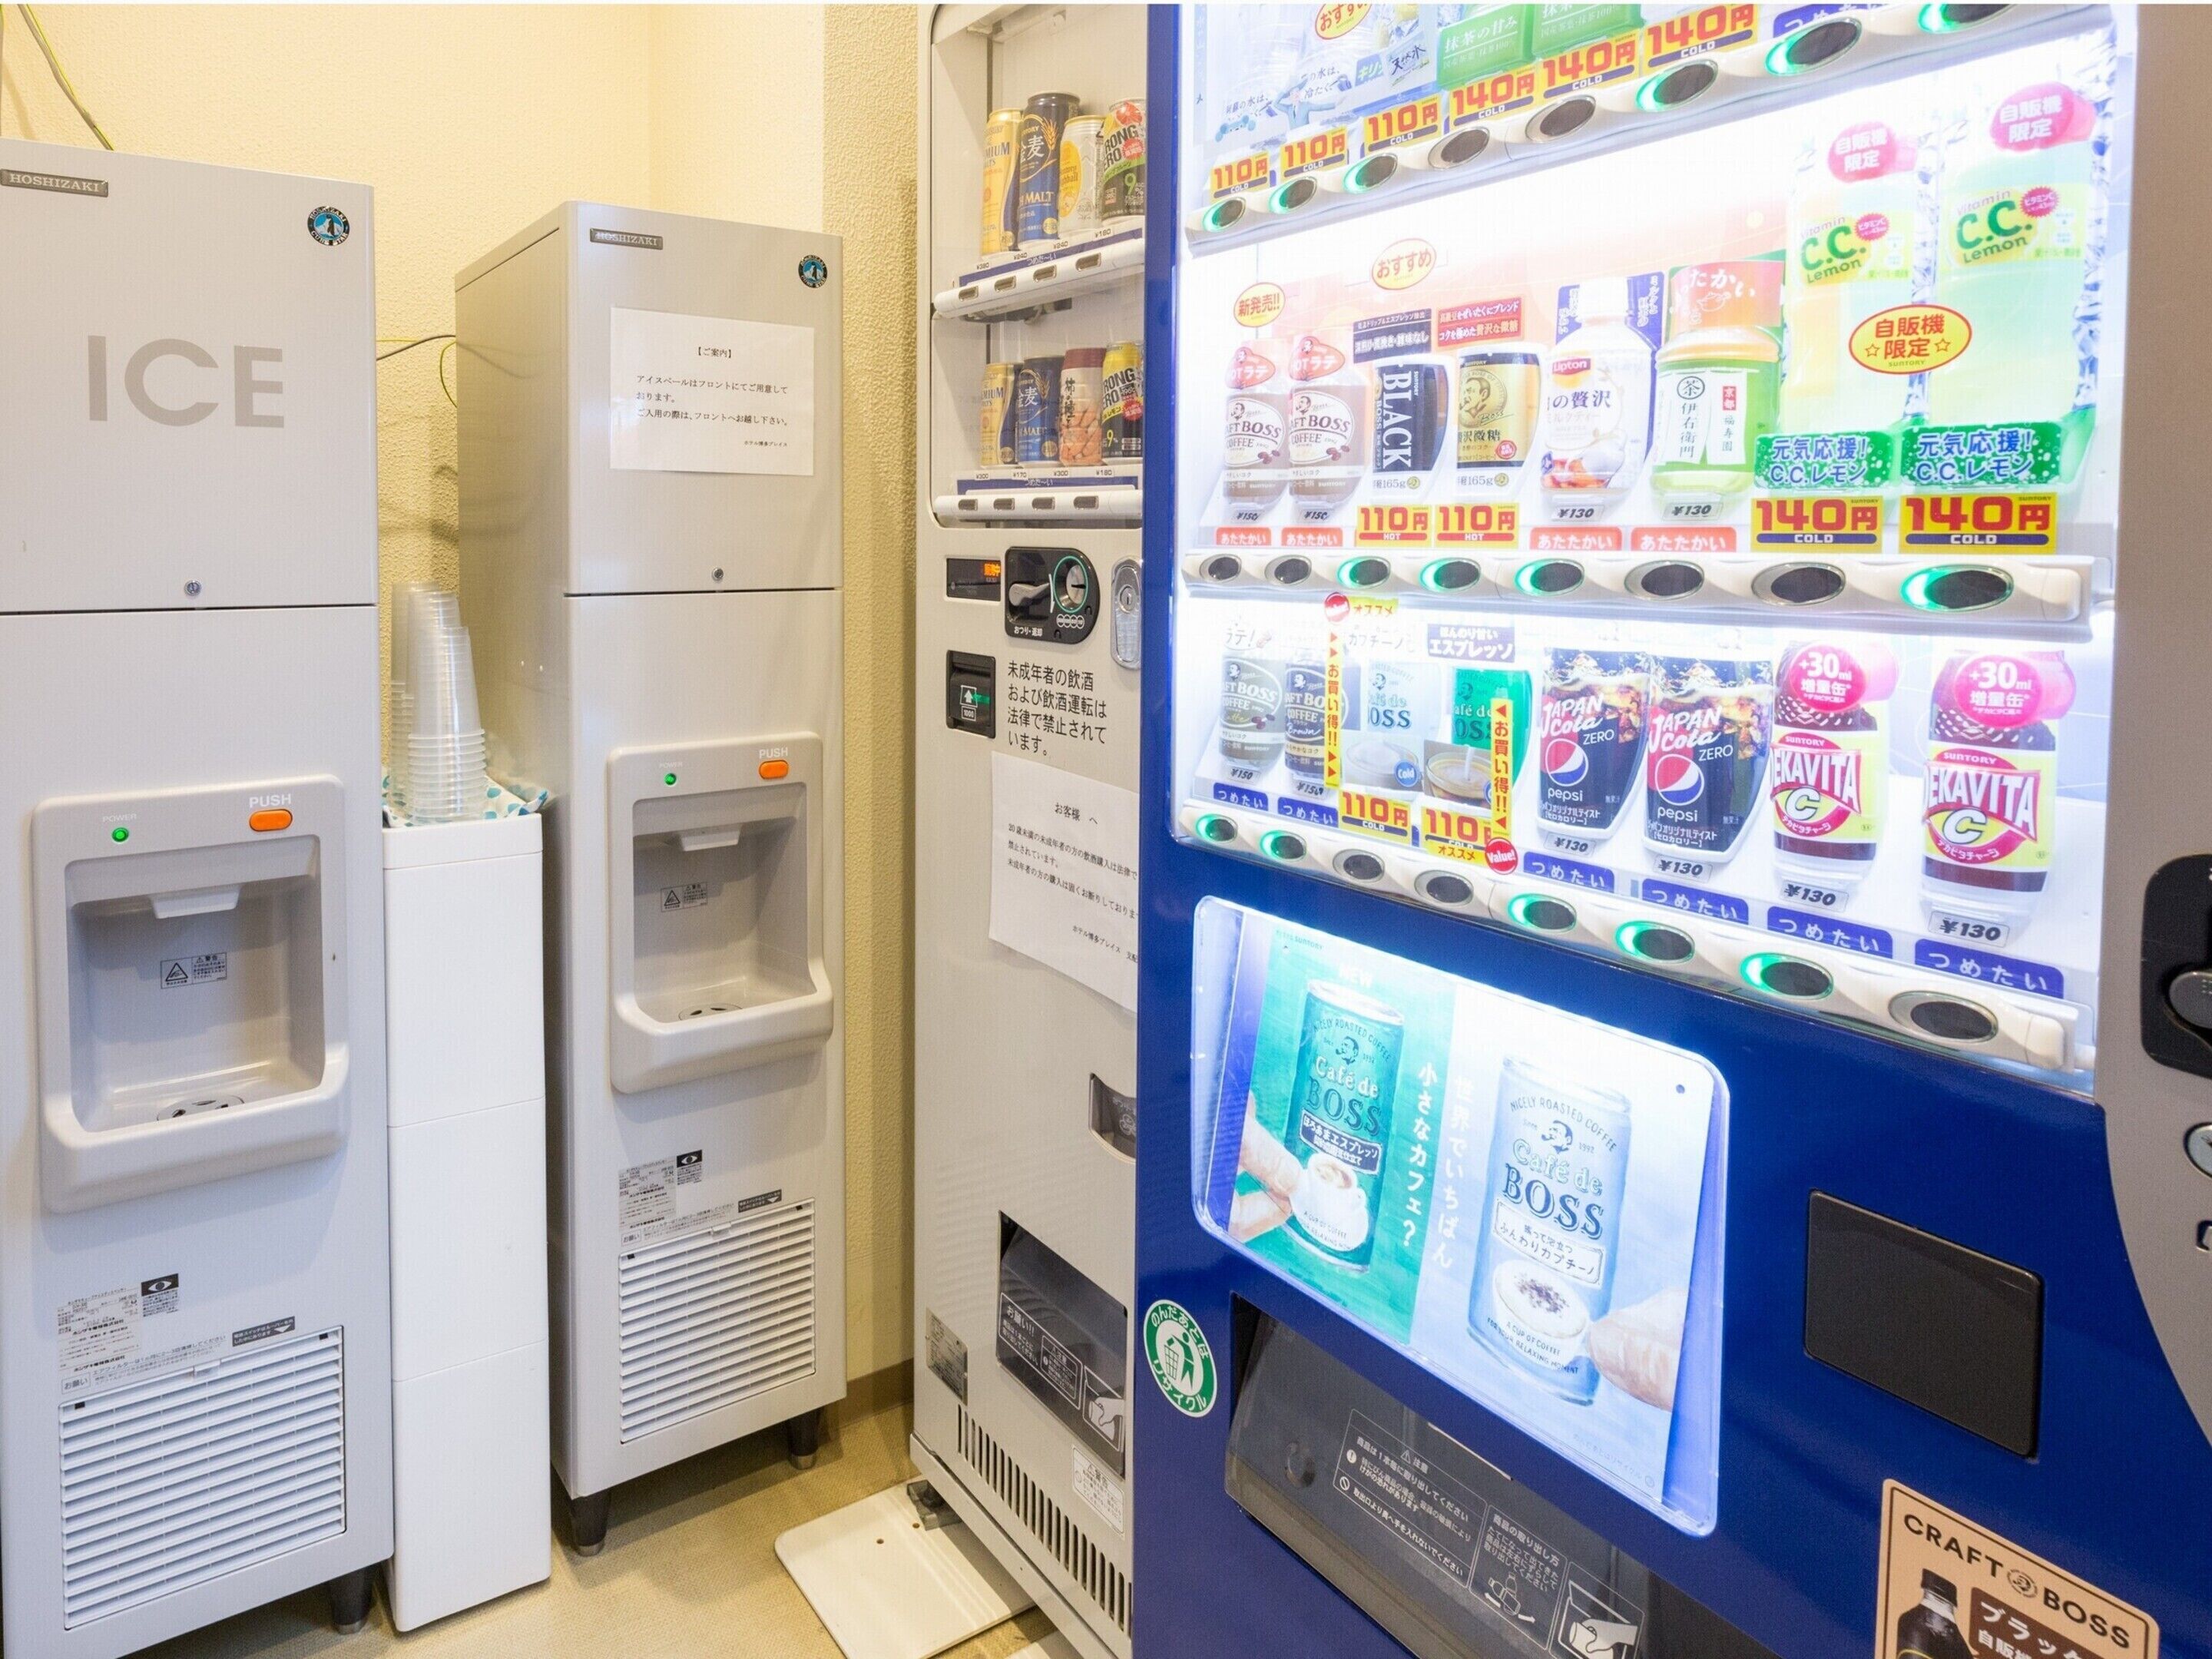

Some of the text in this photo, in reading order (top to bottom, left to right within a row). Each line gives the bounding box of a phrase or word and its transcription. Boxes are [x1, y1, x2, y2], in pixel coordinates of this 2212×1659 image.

[1647, 4, 1754, 55] 140円
[1543, 39, 1635, 87] 140円
[1452, 72, 1535, 115] 140円
[1479, 105, 1505, 119] COLD
[1999, 94, 2064, 124] 自販機
[1368, 104, 1439, 141] 110円
[2008, 118, 2052, 144] 限定
[1284, 133, 1345, 168] 110円
[1389, 132, 1414, 145] COLD
[1834, 127, 1888, 155] 自販機
[1214, 157, 1267, 189] 110円
[1303, 161, 1323, 172] COLD
[1843, 155, 1881, 174] 限定
[10, 172, 100, 194] HOSHIZAKI
[1230, 183, 1249, 194] COLD
[1956, 189, 2011, 215] Vitamin
[1955, 200, 2033, 250] C.C.
[595, 232, 658, 247] HOSHIZAKI
[1800, 225, 1867, 271] C.C.
[1963, 235, 2028, 264] Lemon
[1376, 247, 1432, 279] おすすめ
[1806, 257, 1862, 284] Lemon
[1238, 293, 1280, 317] 新発売!!
[1874, 313, 1945, 339] 自販機
[697, 346, 732, 359] 【ご案内】
[1883, 336, 1932, 360] 限定
[1552, 360, 1588, 373] Lipton
[88, 336, 284, 429] ICE
[636, 392, 675, 403] おります。
[1242, 421, 1282, 439] BOSS
[1309, 415, 1351, 433] BOSS
[1382, 371, 1412, 469] BLACK
[1680, 402, 1698, 458] 伊右衛門
[1772, 436, 1868, 461] 元気応援!
[1918, 430, 2033, 458] 元気応援!
[1770, 462, 1867, 484] C.C.レモン
[1915, 456, 2033, 482] C.C.レモン
[1361, 507, 1428, 531] 110円
[1439, 506, 1515, 531] 110円
[1559, 508, 1594, 519] ¥130
[1671, 505, 1712, 517] ¥130
[1756, 498, 1879, 531] 140円
[1905, 496, 2050, 532] 140円
[1220, 535, 1267, 545] あたたかい
[1286, 534, 1338, 546] あたたかい
[1383, 533, 1401, 541] HOT
[1465, 532, 1485, 541] HOT
[1538, 535, 1613, 550] あたたかい
[1640, 535, 1727, 551] あたたかい
[1794, 534, 1834, 544] COLD
[1429, 639, 1515, 661] エスプレッソ
[1008, 661, 1094, 691] 未成年者の飲酒
[1798, 651, 1853, 682] +30ml
[1969, 662, 2032, 691] +30ml
[1008, 684, 1108, 718] および飲酒運転は
[1237, 682, 1277, 702] BOSS
[1287, 709, 1318, 723] COFFEE
[1328, 663, 1339, 747] お買い得!!
[1541, 693, 1604, 731] JAPAN
[1008, 707, 1107, 743] 法律で禁止されて
[1548, 715, 1604, 738] Cola
[1649, 705, 1722, 747] JAPAN
[1008, 730, 1048, 756] います。
[1582, 730, 1614, 746] ZERO
[1659, 731, 1721, 753] Cola
[759, 747, 789, 759] PUSH
[1698, 745, 1734, 762] ZERO
[1231, 768, 1253, 780] ¥150
[1397, 767, 1415, 779] Cold
[1494, 720, 1509, 813] お買い得!!
[249, 793, 292, 809] PUSH
[1218, 790, 1263, 809] つめたい
[1548, 786, 1584, 803] pepsi
[1785, 788, 1821, 822] C
[102, 813, 137, 823] POWER
[1055, 802, 1099, 825] お客様 へ
[1283, 804, 1334, 825] つめたい
[1343, 793, 1409, 828] 110円
[1657, 806, 1698, 823] pepsi
[1942, 808, 1988, 845] C
[1437, 844, 1475, 861] オススメ
[1486, 850, 1517, 863] Value!
[1555, 837, 1588, 853] ¥130
[1531, 861, 1605, 886] つめたい
[1659, 859, 1704, 876] ¥130
[1008, 857, 1138, 919] 未成年者の方の購入は固くお断りしておりま
[1783, 884, 1837, 906] ¥130
[1652, 889, 1738, 919] つめたい
[1294, 936, 1325, 950] SUNTORY
[1778, 918, 1879, 954] つめたい
[1939, 919, 2002, 942] ¥130
[1338, 963, 1374, 988] NEW
[1929, 949, 2048, 993] つめたい
[1334, 1018, 1368, 1037] ROASTED
[1315, 1055, 1379, 1098] Café de
[1307, 1075, 1382, 1137] BOSS
[1510, 1096, 1584, 1124] NICELY ROASTED
[1303, 1115, 1379, 1158] ほろあまエスプレッソ
[1578, 1142, 1594, 1154] 1992
[1402, 1061, 1438, 1247] 小さなカフェ?
[1432, 1077, 1475, 1269] 世界でいちばん
[1512, 1138, 1604, 1197] Café de
[1502, 1162, 1604, 1240] BOSS
[1500, 1223, 1595, 1276] ふんわりカプチーノ
[1151, 1306, 1209, 1359] のんだあとは
[1512, 1325, 1525, 1336] CUP
[1525, 1334, 1536, 1343] OF
[1515, 1339, 1549, 1364] RELAXING
[1152, 1359, 1207, 1411] リサイクル
[1412, 1458, 1429, 1474] 注意
[1493, 1514, 1560, 1568] 商品の取り出し方
[1484, 1541, 1548, 1592] 取り出してください
[1903, 1513, 2131, 1650] CRAFT BOSS
